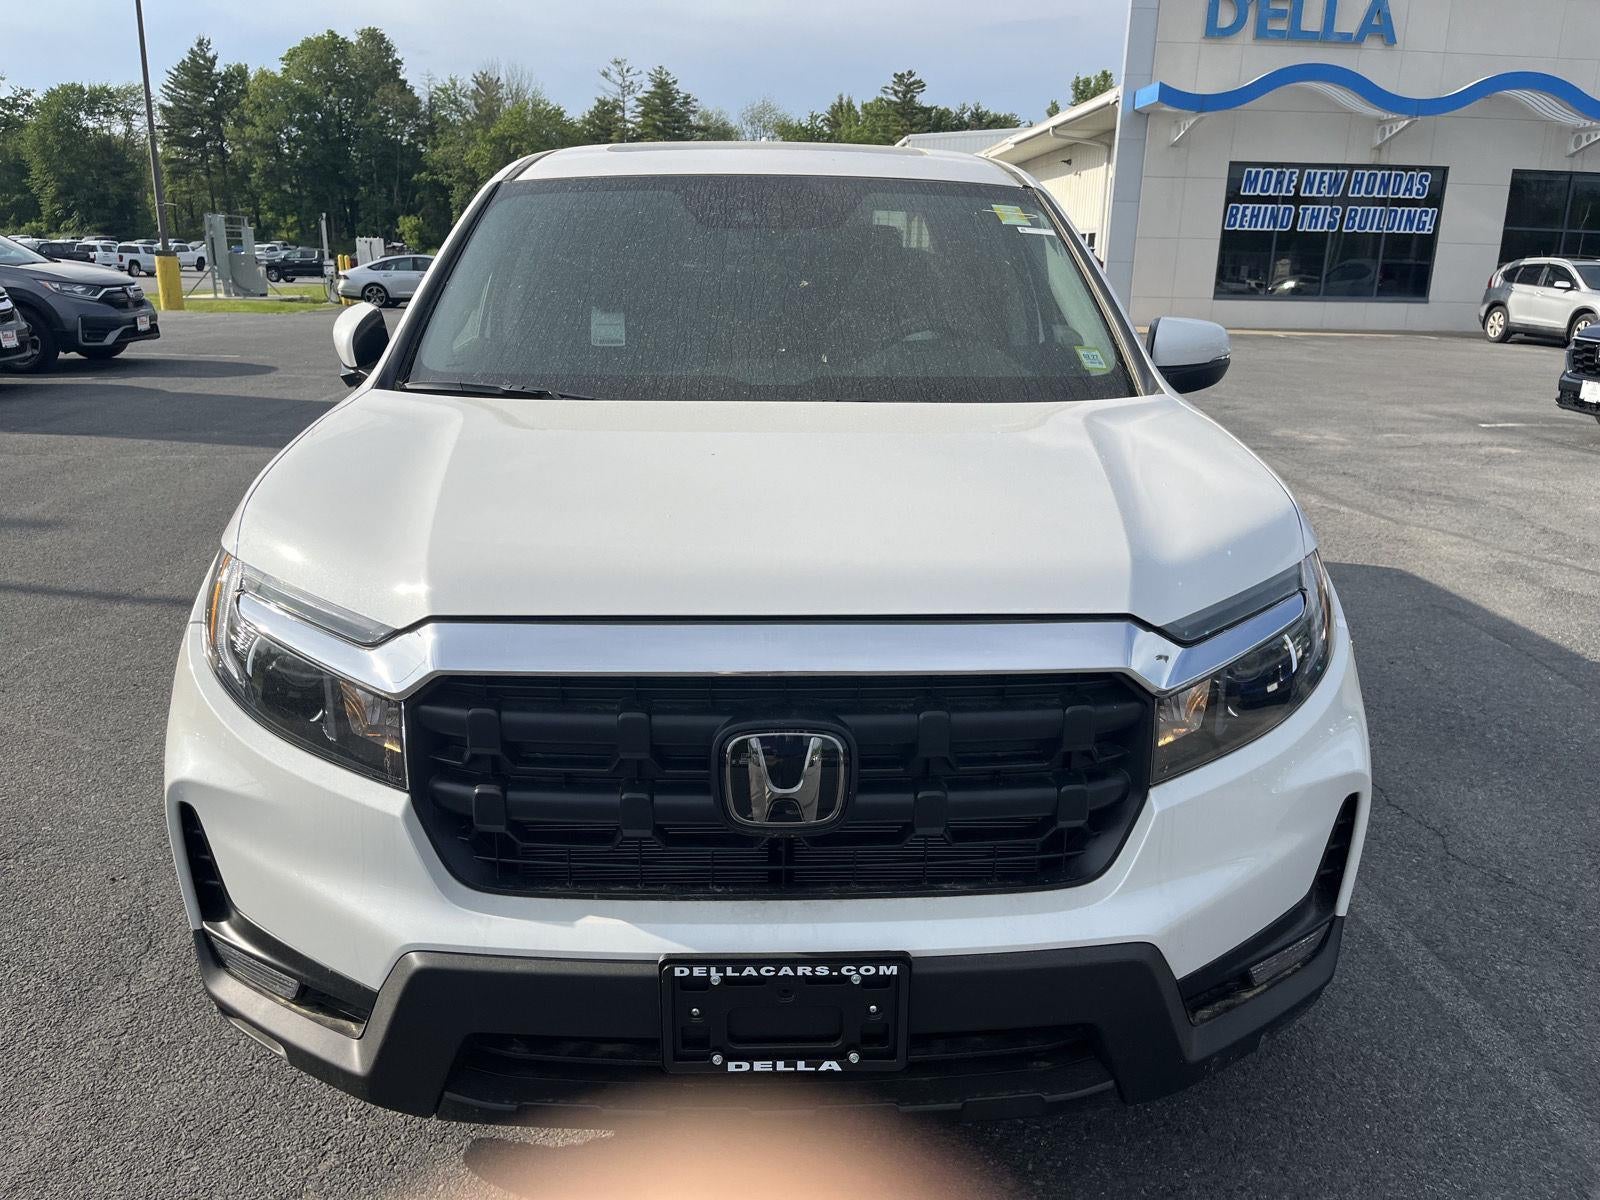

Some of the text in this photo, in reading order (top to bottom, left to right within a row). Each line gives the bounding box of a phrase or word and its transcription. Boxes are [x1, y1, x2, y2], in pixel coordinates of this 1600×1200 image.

[1240, 168, 1431, 199] MORE NEW HONDAS
[1224, 203, 1438, 234] BEHIND THIS BUILDING!
[674, 965, 898, 977] DELLACARS.COM
[727, 1060, 842, 1072] DELLA
